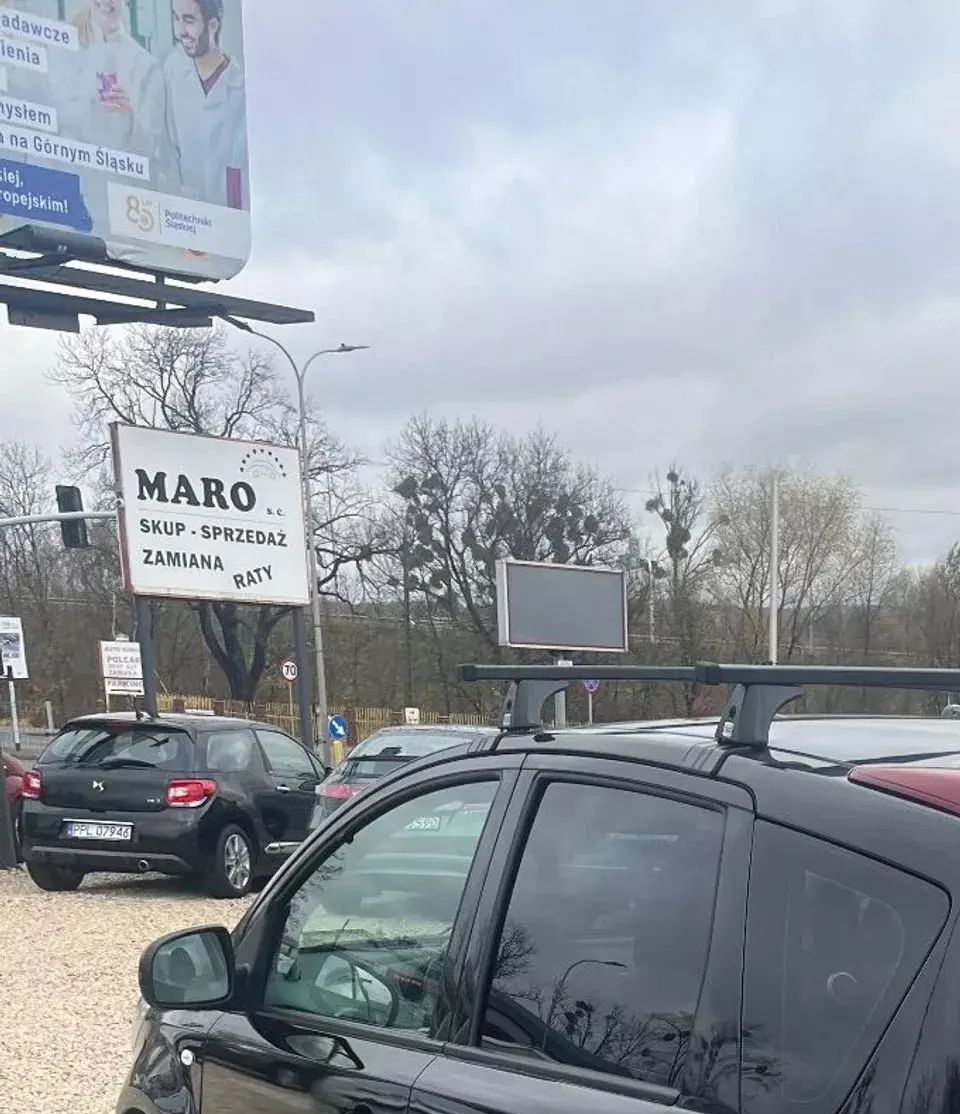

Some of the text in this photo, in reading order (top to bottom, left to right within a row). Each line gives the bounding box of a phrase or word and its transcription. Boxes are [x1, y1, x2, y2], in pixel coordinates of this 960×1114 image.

[10, 133, 28, 149] na
[33, 135, 90, 163] Górnym
[96, 145, 144, 174] Śląsku
[0, 167, 24, 188] iej,
[134, 468, 256, 512] MARO
[139, 518, 186, 537] SKUP
[201, 525, 288, 548] SPRZEDAŻ
[142, 549, 225, 572] ZAMIANA
[233, 565, 273, 590] RATY
[284, 664, 297, 677] 70
[73, 825, 130, 839] PPL 07946
